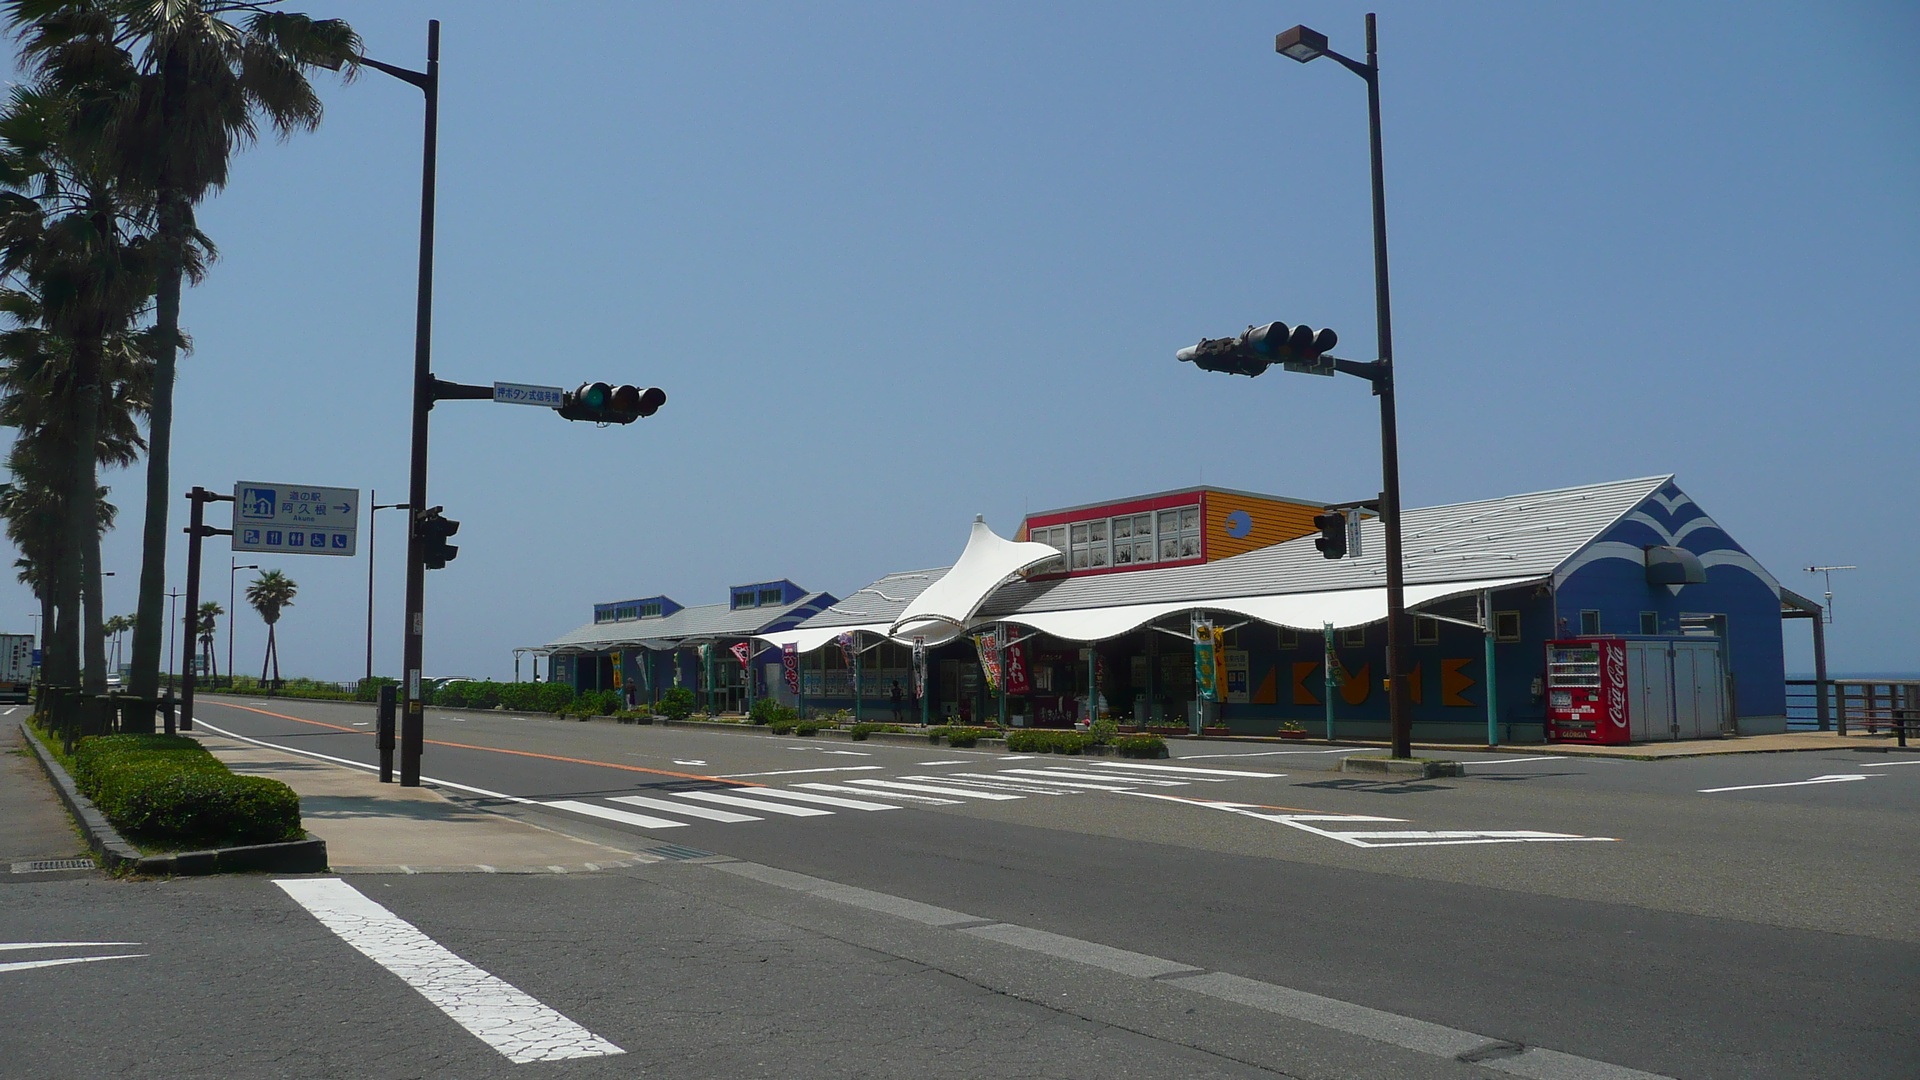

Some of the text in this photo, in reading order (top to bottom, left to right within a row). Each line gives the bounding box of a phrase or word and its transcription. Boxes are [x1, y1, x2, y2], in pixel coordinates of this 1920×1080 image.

[497, 386, 560, 403] 押ボタン式信号機
[290, 491, 321, 502] 道の駅
[282, 502, 327, 516] 阿久根
[1606, 641, 1626, 728] Coca-Cola
